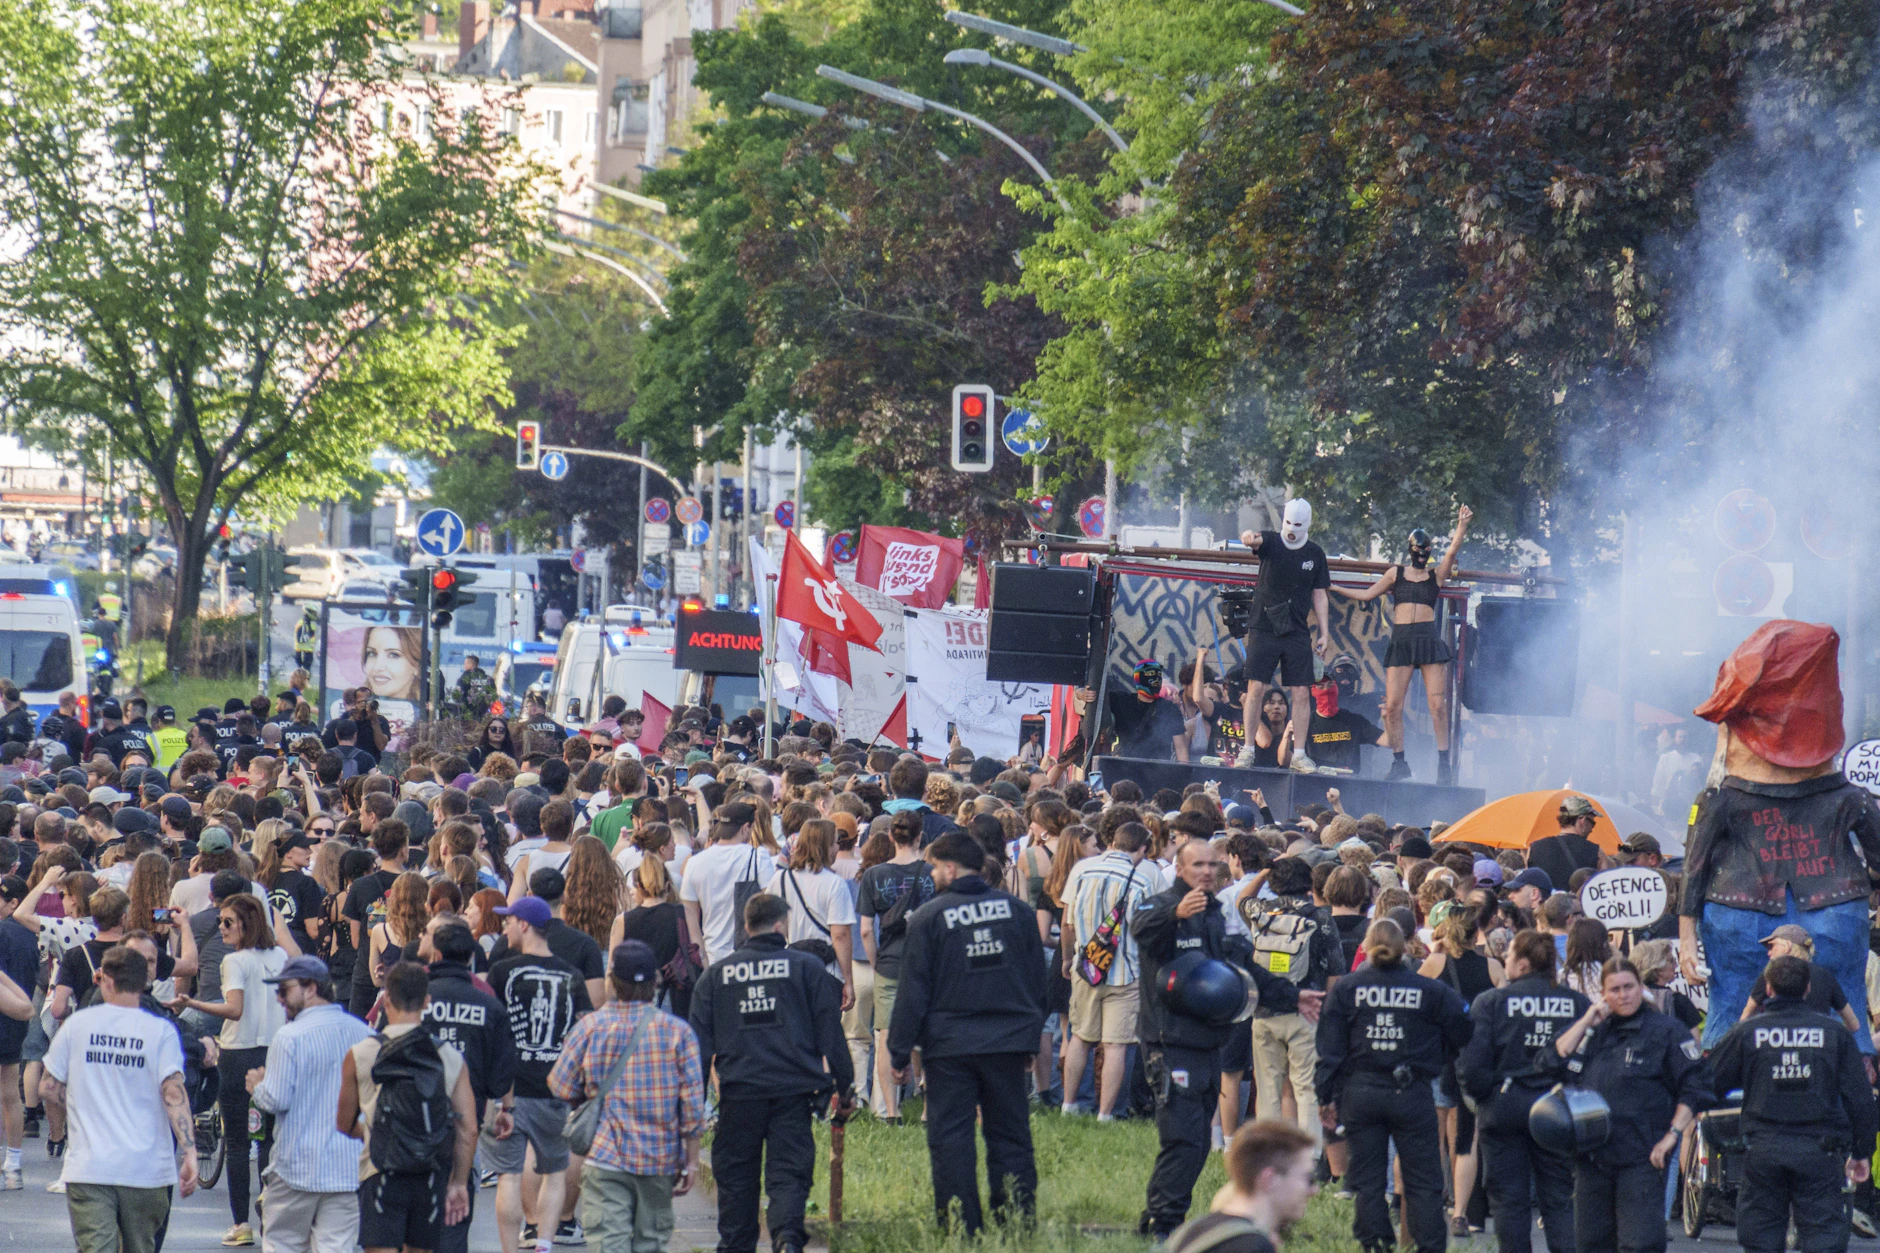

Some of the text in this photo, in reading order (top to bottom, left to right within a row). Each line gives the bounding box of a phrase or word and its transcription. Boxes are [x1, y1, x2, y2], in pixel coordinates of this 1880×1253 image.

[890, 546, 932, 562] links
[1752, 807, 1784, 827] DER
[1760, 839, 1821, 863] BLEIBT
[1795, 856, 1836, 877] AUF!
[1588, 876, 1663, 901] DE-FENCE
[943, 898, 1012, 930] POLIZEI
[1595, 899, 1652, 920] GÖRLI!
[973, 928, 992, 944] BE
[1176, 937, 1202, 949] POLIZEI
[966, 939, 1005, 958] 21215
[722, 958, 790, 985] POLIZEI
[747, 985, 766, 1000] BE
[1355, 986, 1423, 1010] POLIZEI
[420, 1000, 486, 1027] POLIZEI
[739, 997, 776, 1014] 21217
[1507, 995, 1575, 1018] POLIZEI
[1376, 1013, 1394, 1027] BE
[1535, 1021, 1552, 1034] BE
[439, 1027, 457, 1041] BE
[1365, 1025, 1405, 1039] 21201
[1524, 1033, 1551, 1048] 212
[1755, 1027, 1824, 1049] POLIZEI
[90, 1033, 144, 1051] LISTEN TO
[86, 1051, 145, 1069] BILLY BOYO
[1781, 1051, 1800, 1066] BE
[1772, 1063, 1811, 1079] 21216
